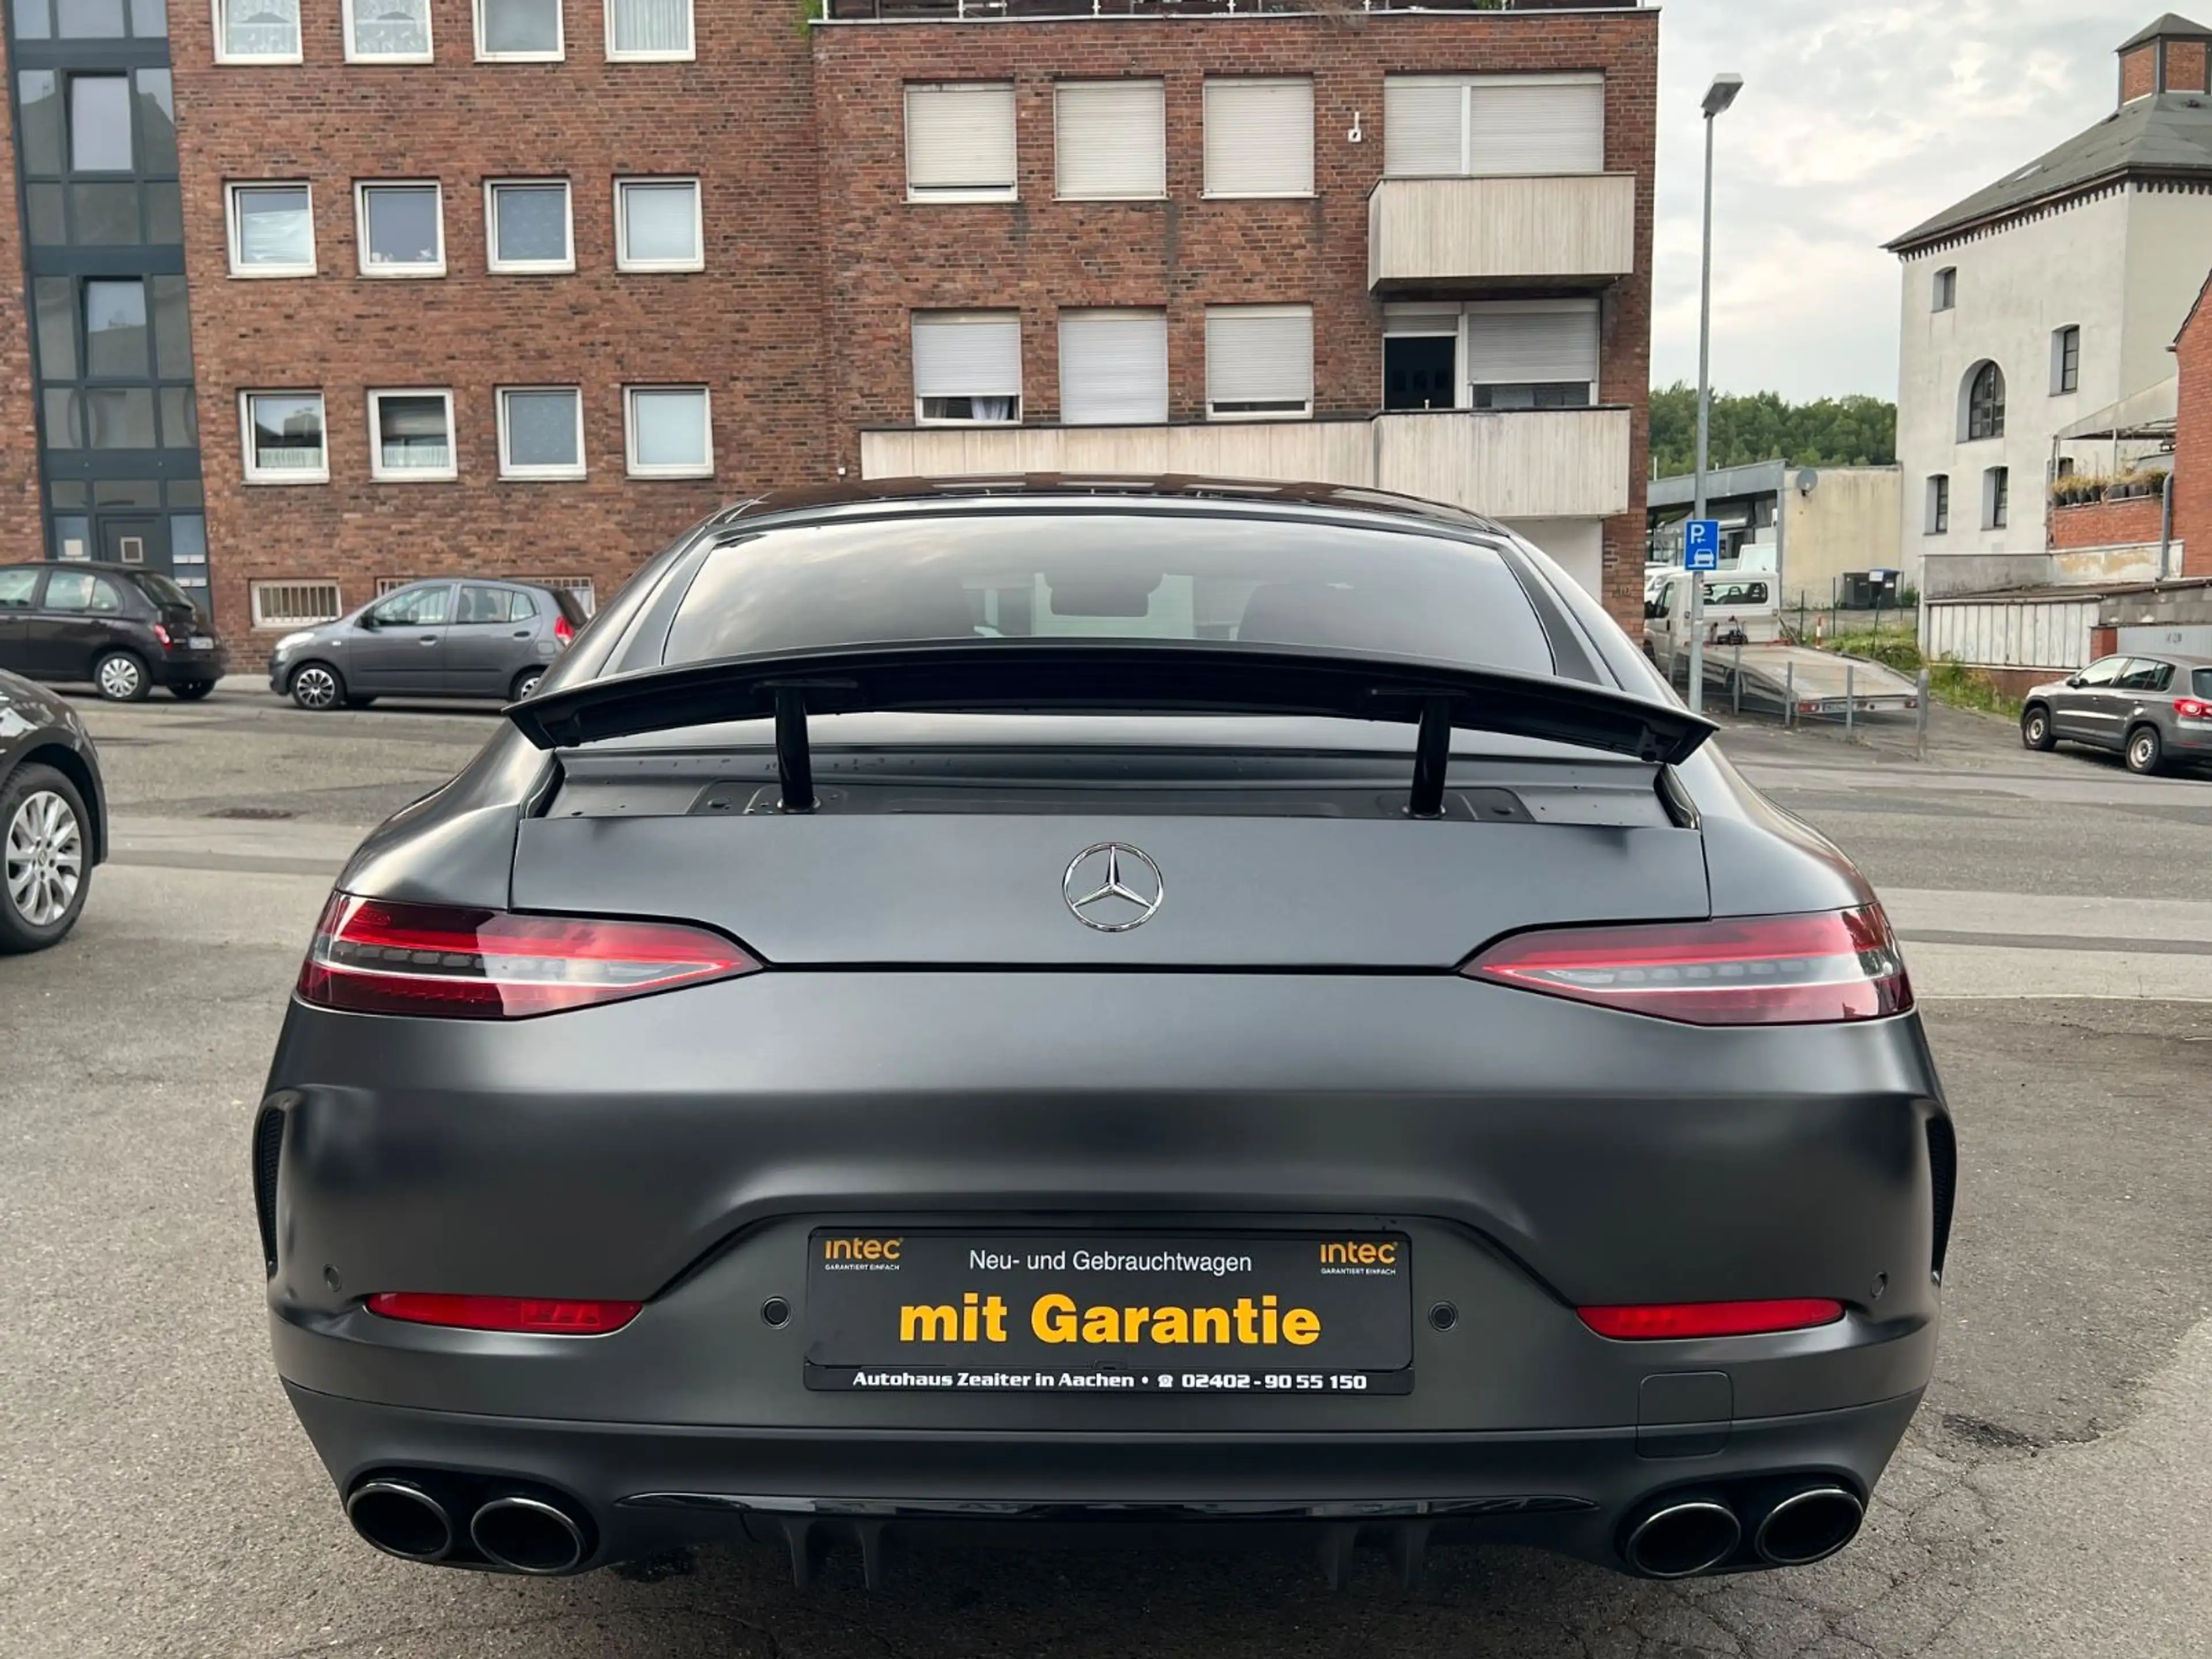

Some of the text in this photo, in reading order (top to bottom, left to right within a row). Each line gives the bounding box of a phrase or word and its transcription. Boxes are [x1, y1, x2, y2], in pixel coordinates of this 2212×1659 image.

[1691, 524, 1705, 544] P
[825, 1238, 900, 1259] intec
[1320, 1241, 1396, 1264] intec
[970, 1249, 1252, 1277] Neu- und Gebrauchtwagen
[900, 1292, 1321, 1346] mit Garantie
[853, 1372, 953, 1387] Autohaus
[1035, 1372, 1055, 1387] in
[1058, 1373, 1135, 1388] Aachen
[1181, 1374, 1251, 1389] 02402
[1264, 1374, 1292, 1389] 90
[1296, 1375, 1323, 1389] 55
[1330, 1375, 1367, 1389] 150
